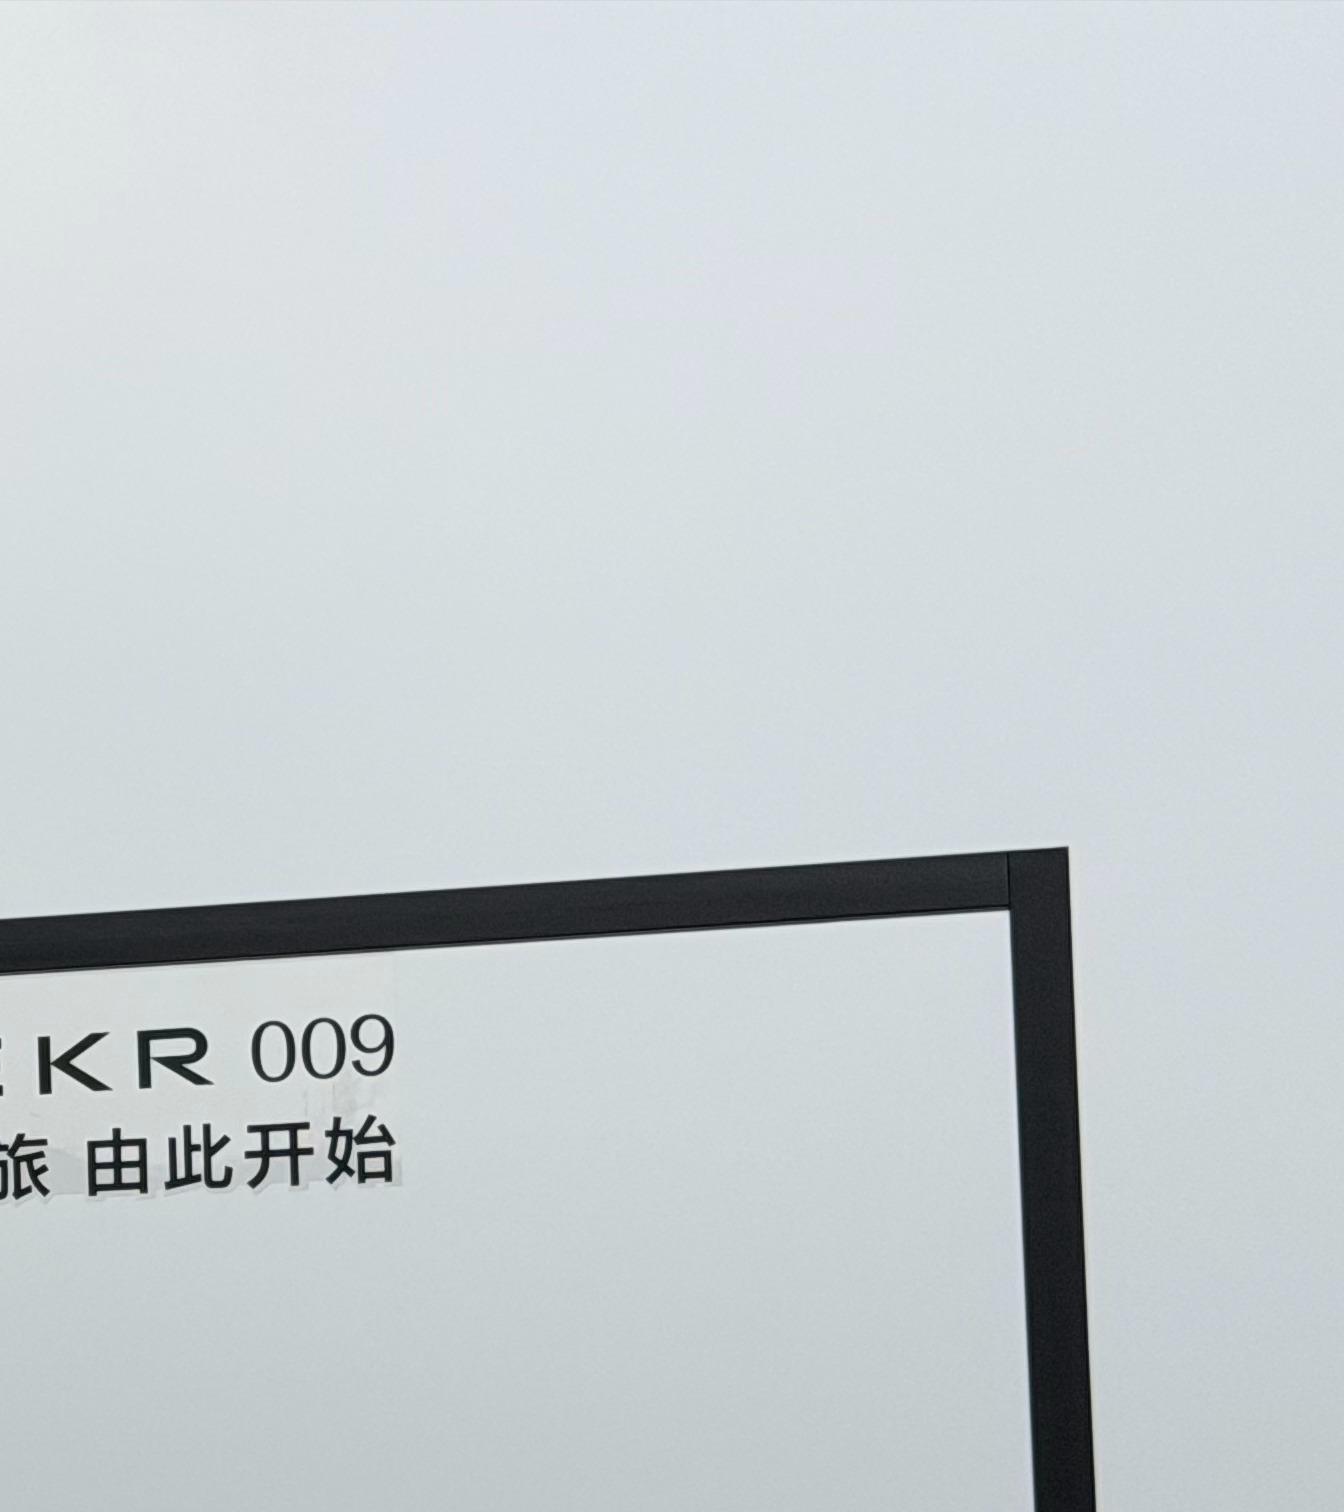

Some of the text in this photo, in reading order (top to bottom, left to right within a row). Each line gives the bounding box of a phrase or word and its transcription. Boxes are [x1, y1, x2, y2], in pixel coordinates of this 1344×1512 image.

[251, 1013, 395, 1083] 009
[86, 1114, 396, 1197] 由此开始
